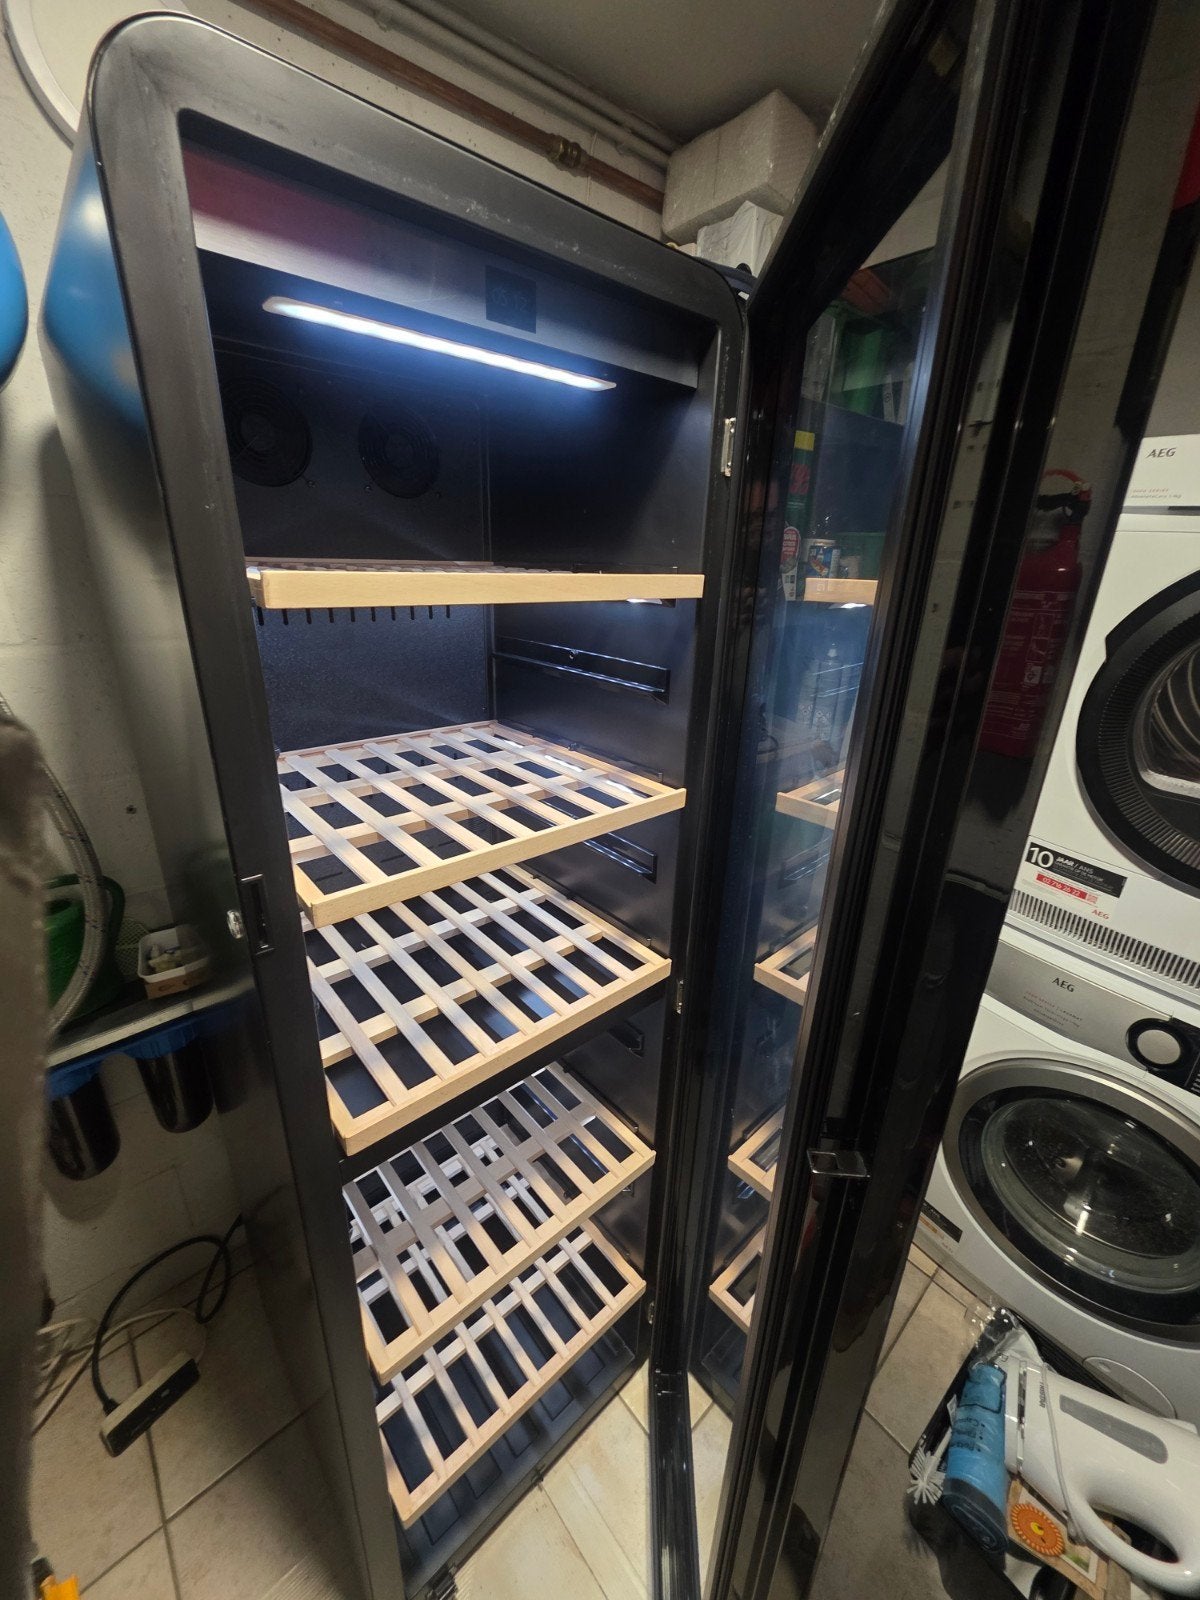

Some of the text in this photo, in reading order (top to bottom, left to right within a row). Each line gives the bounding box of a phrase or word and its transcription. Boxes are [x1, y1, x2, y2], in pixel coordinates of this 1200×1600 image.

[1145, 447, 1178, 458] AEG
[1030, 847, 1054, 868] 10
[1079, 865, 1095, 874] ANS
[1092, 909, 1110, 920] AEG
[1052, 977, 1075, 993] AEG
